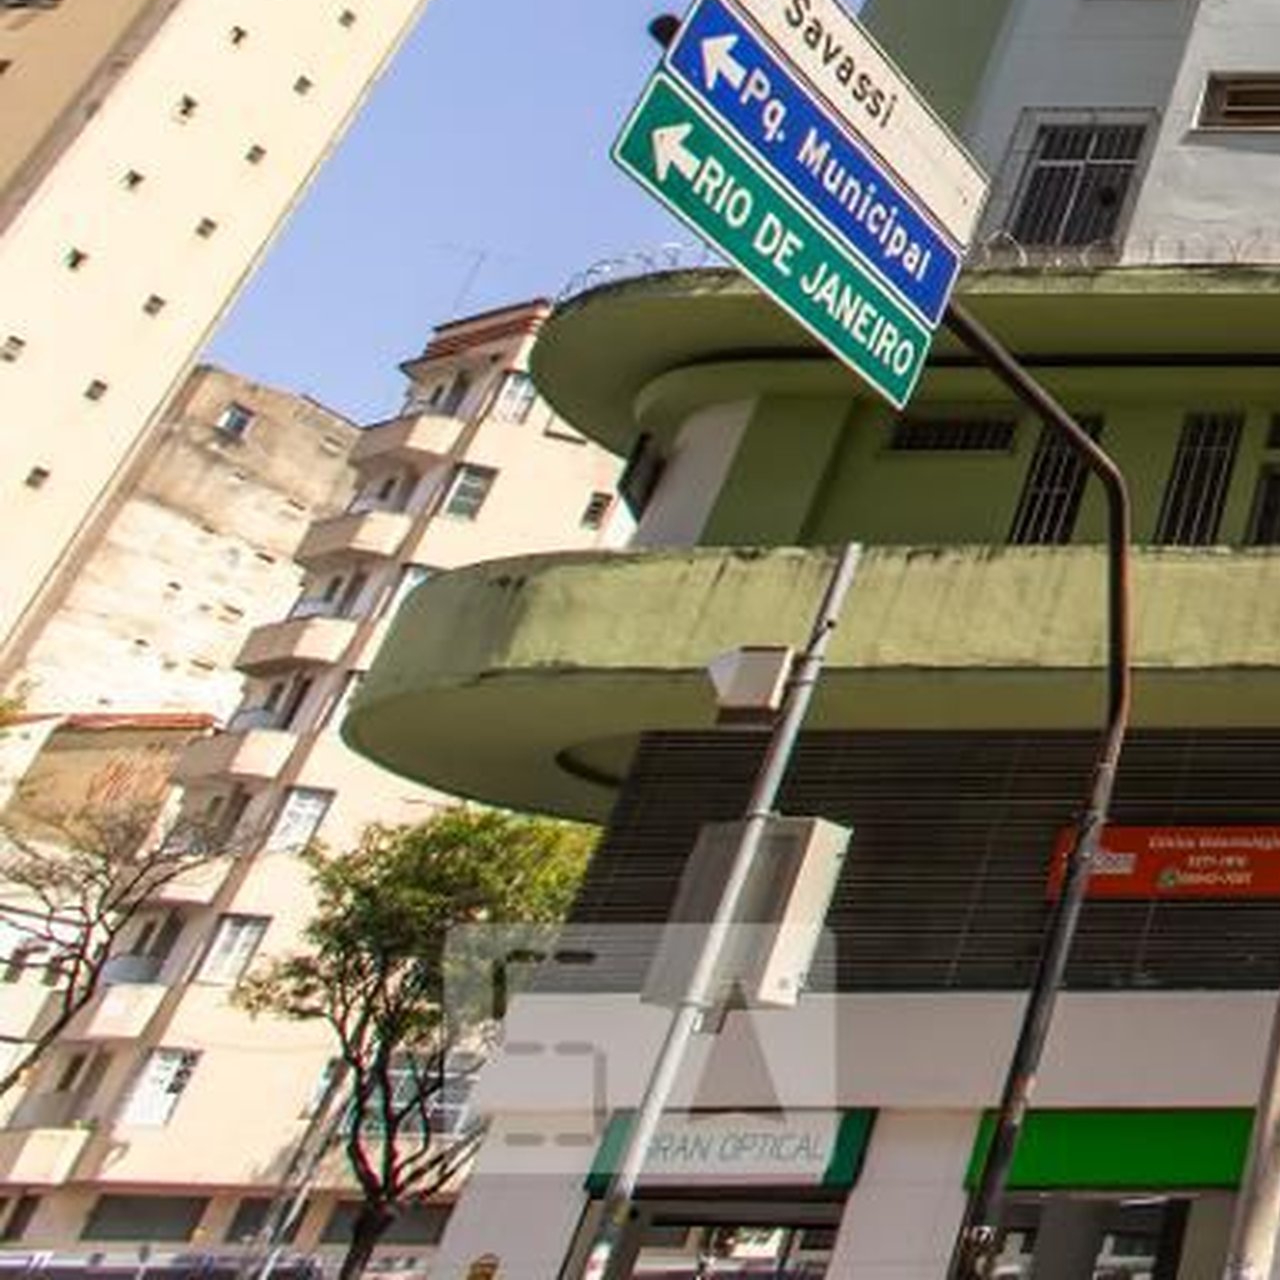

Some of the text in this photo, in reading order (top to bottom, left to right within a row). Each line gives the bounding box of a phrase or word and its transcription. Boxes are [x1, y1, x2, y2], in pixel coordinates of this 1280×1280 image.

[692, 156, 916, 377] RIO DE JANEIRO
[740, 72, 932, 282] Pq. Municipal
[718, 1131, 825, 1163] OPTICAL
